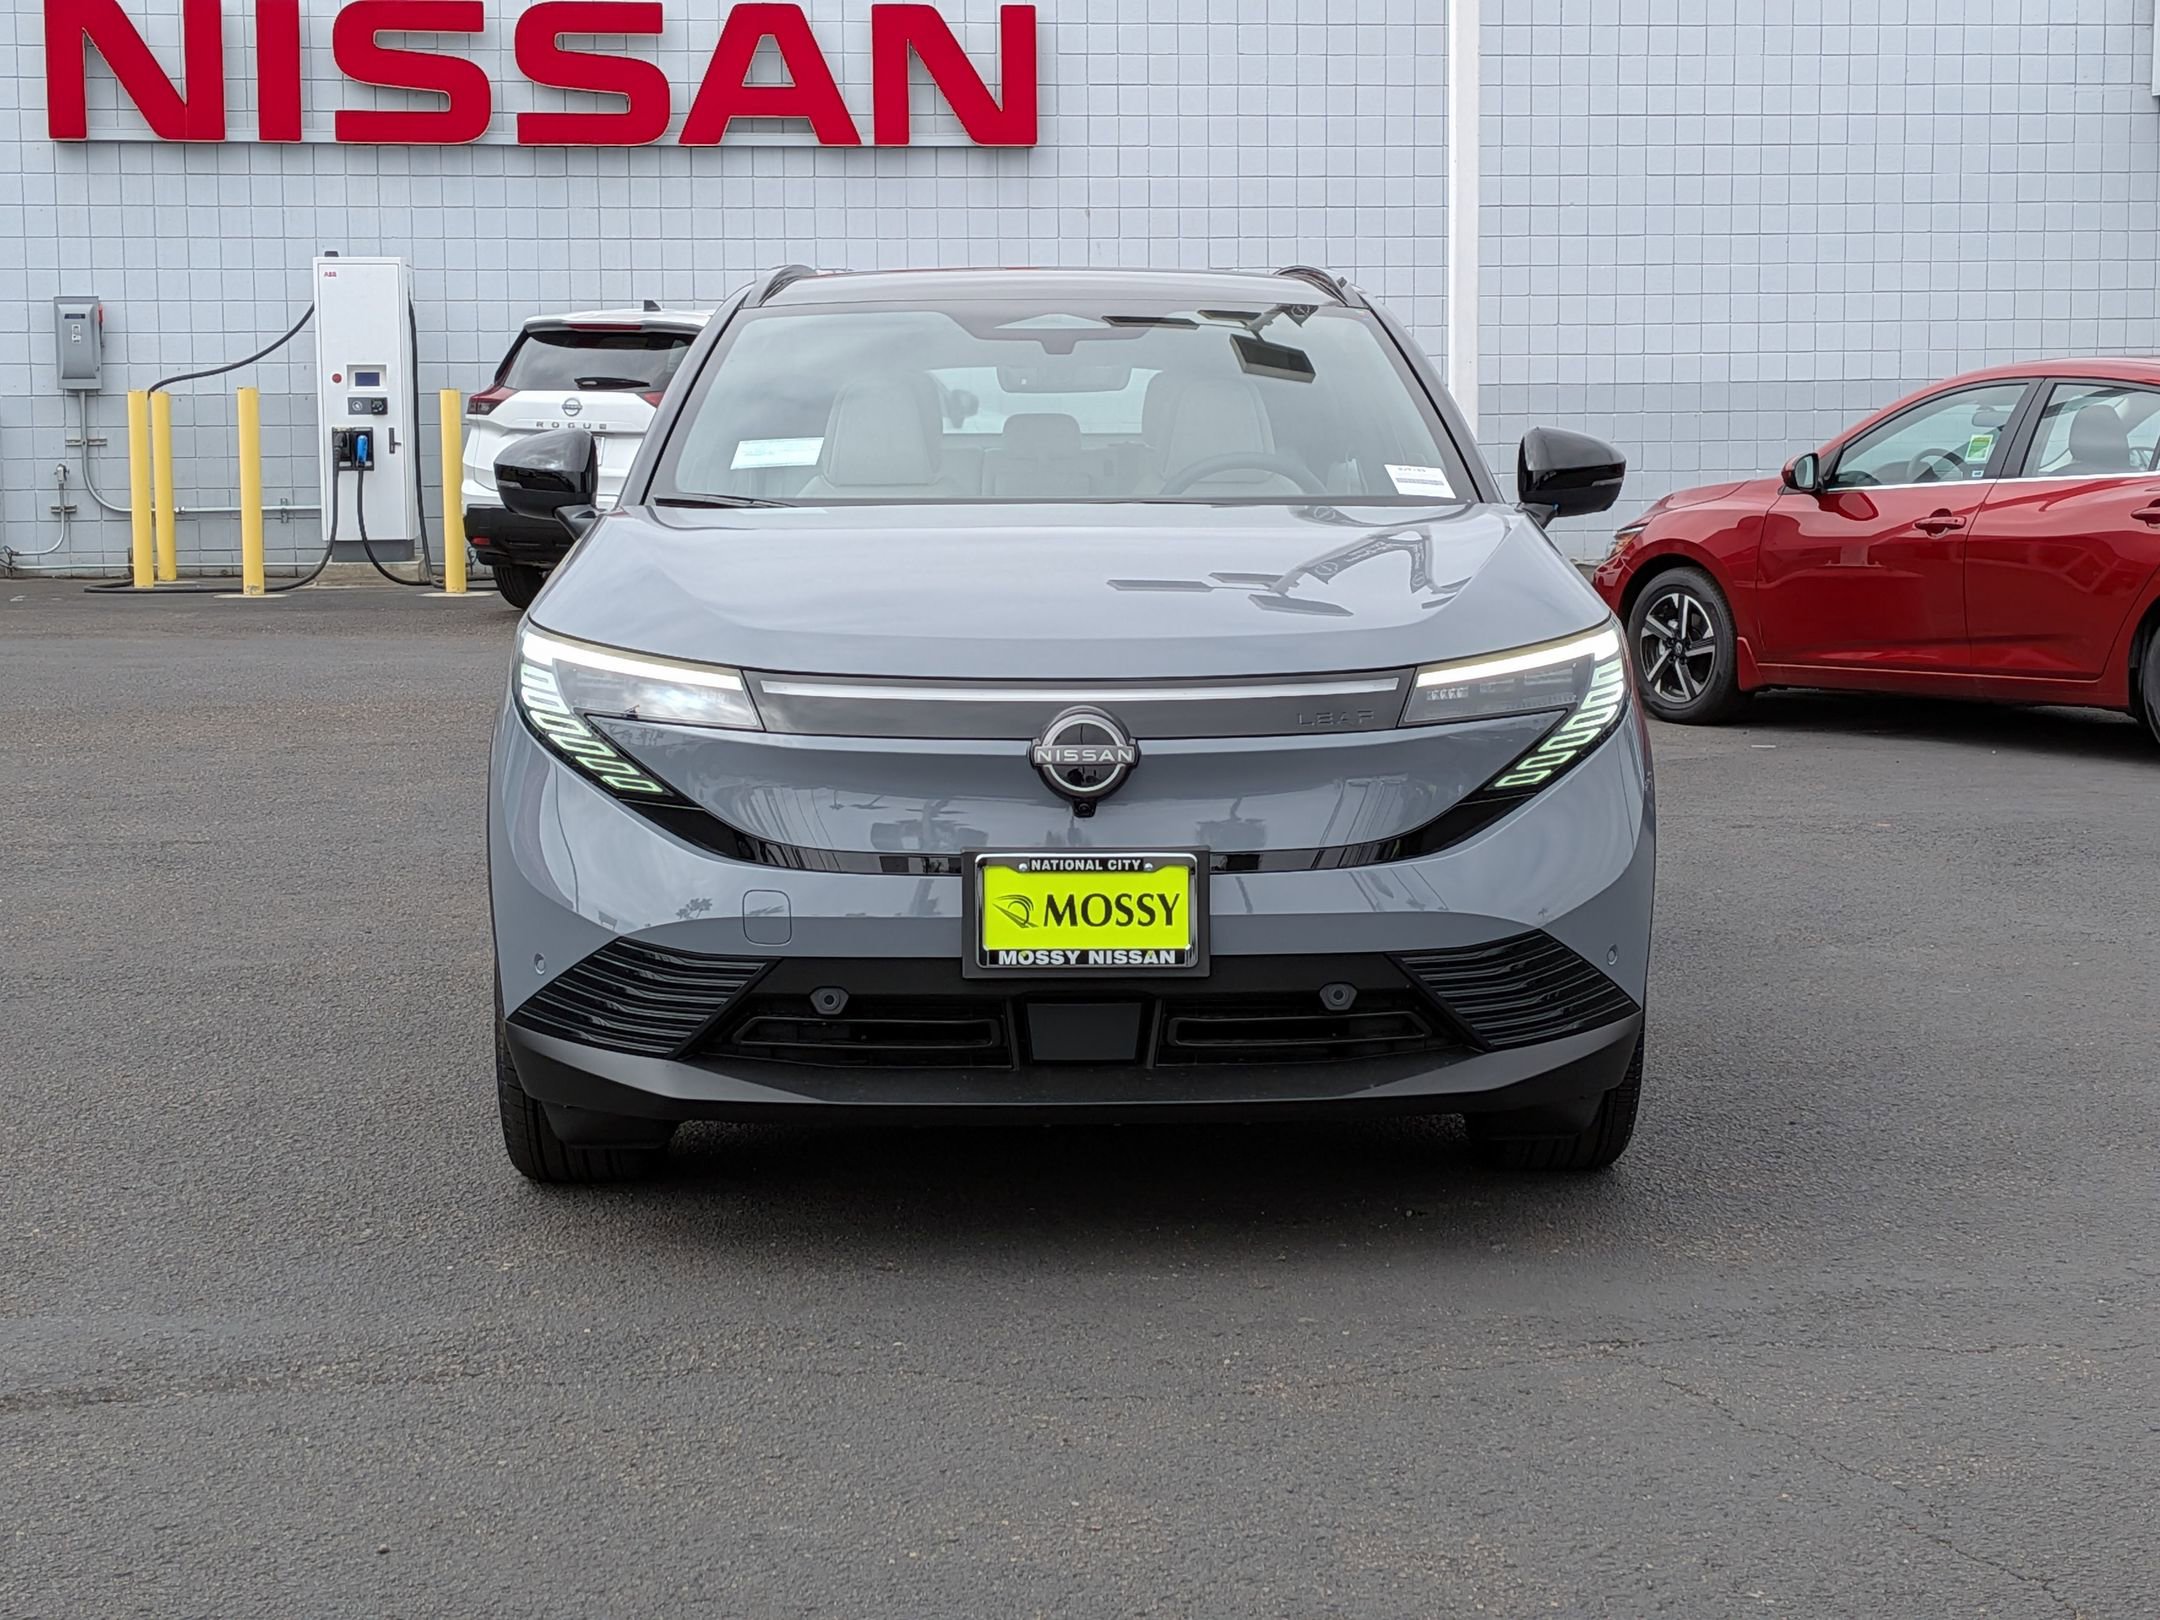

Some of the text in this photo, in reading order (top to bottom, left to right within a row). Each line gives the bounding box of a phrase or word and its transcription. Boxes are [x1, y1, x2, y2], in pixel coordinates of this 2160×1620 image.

[45, 0, 1037, 147] NISSAN
[536, 421, 607, 430] ROGUE
[1297, 709, 1374, 727] LEAF
[1037, 748, 1133, 762] NISSAN
[1031, 859, 1142, 871] NATIONAL CITY
[1043, 892, 1180, 927] MOSSY
[998, 950, 1176, 966] MOSSY NISSAN
